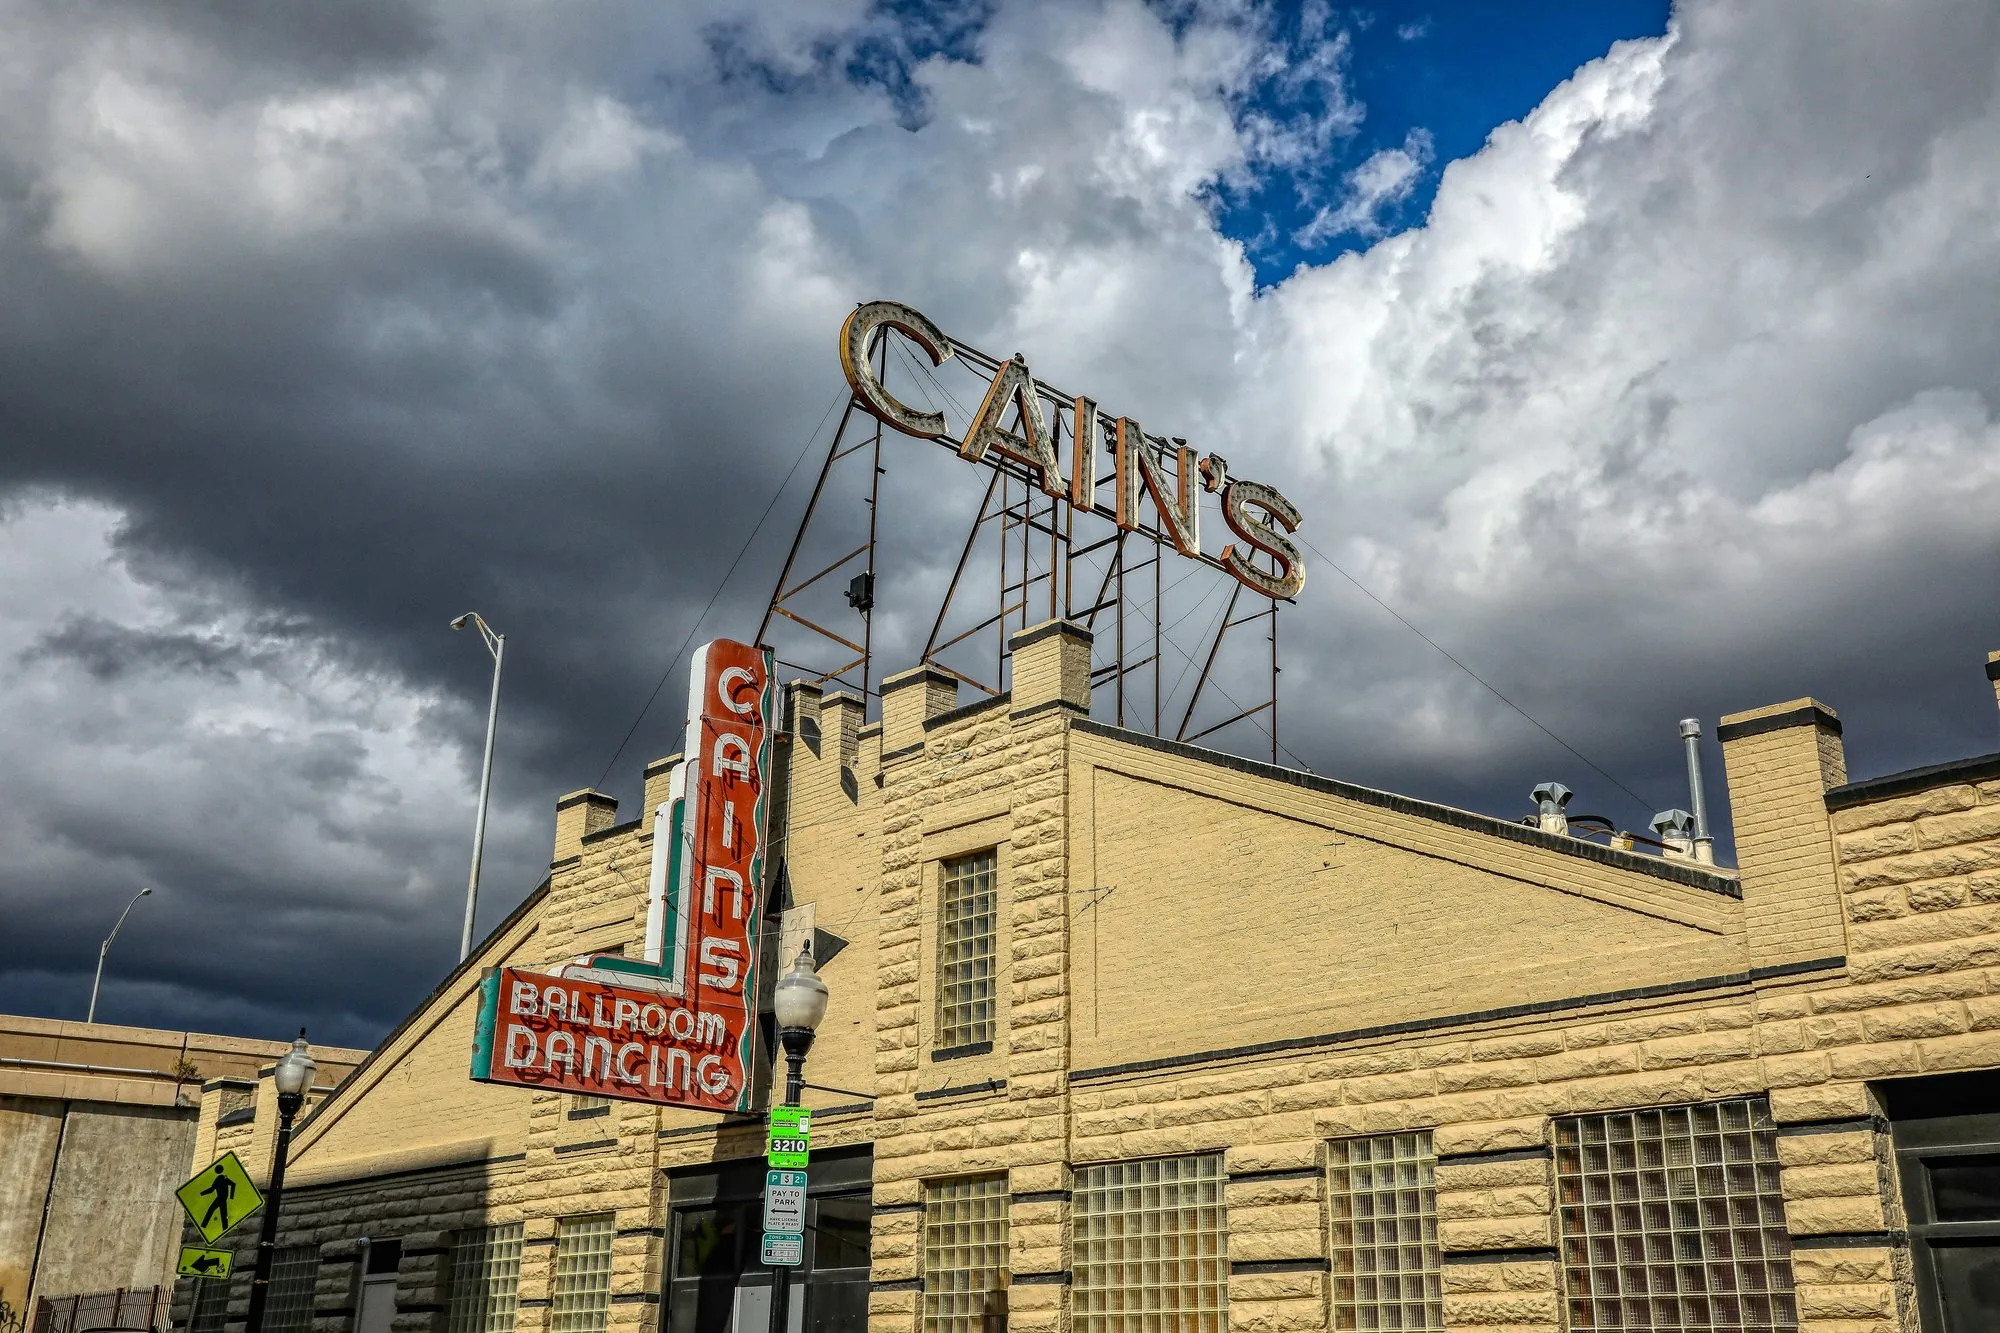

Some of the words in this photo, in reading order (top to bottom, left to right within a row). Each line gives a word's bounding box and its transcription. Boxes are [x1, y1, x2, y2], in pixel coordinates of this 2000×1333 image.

[839, 300, 1306, 600] CAIN'S
[699, 666, 755, 990] CAINS
[509, 980, 726, 1046] BALLROOM
[504, 1023, 731, 1095] DANCING
[772, 1174, 778, 1182] P
[773, 1140, 806, 1152] 3210
[784, 1175, 790, 1184] $
